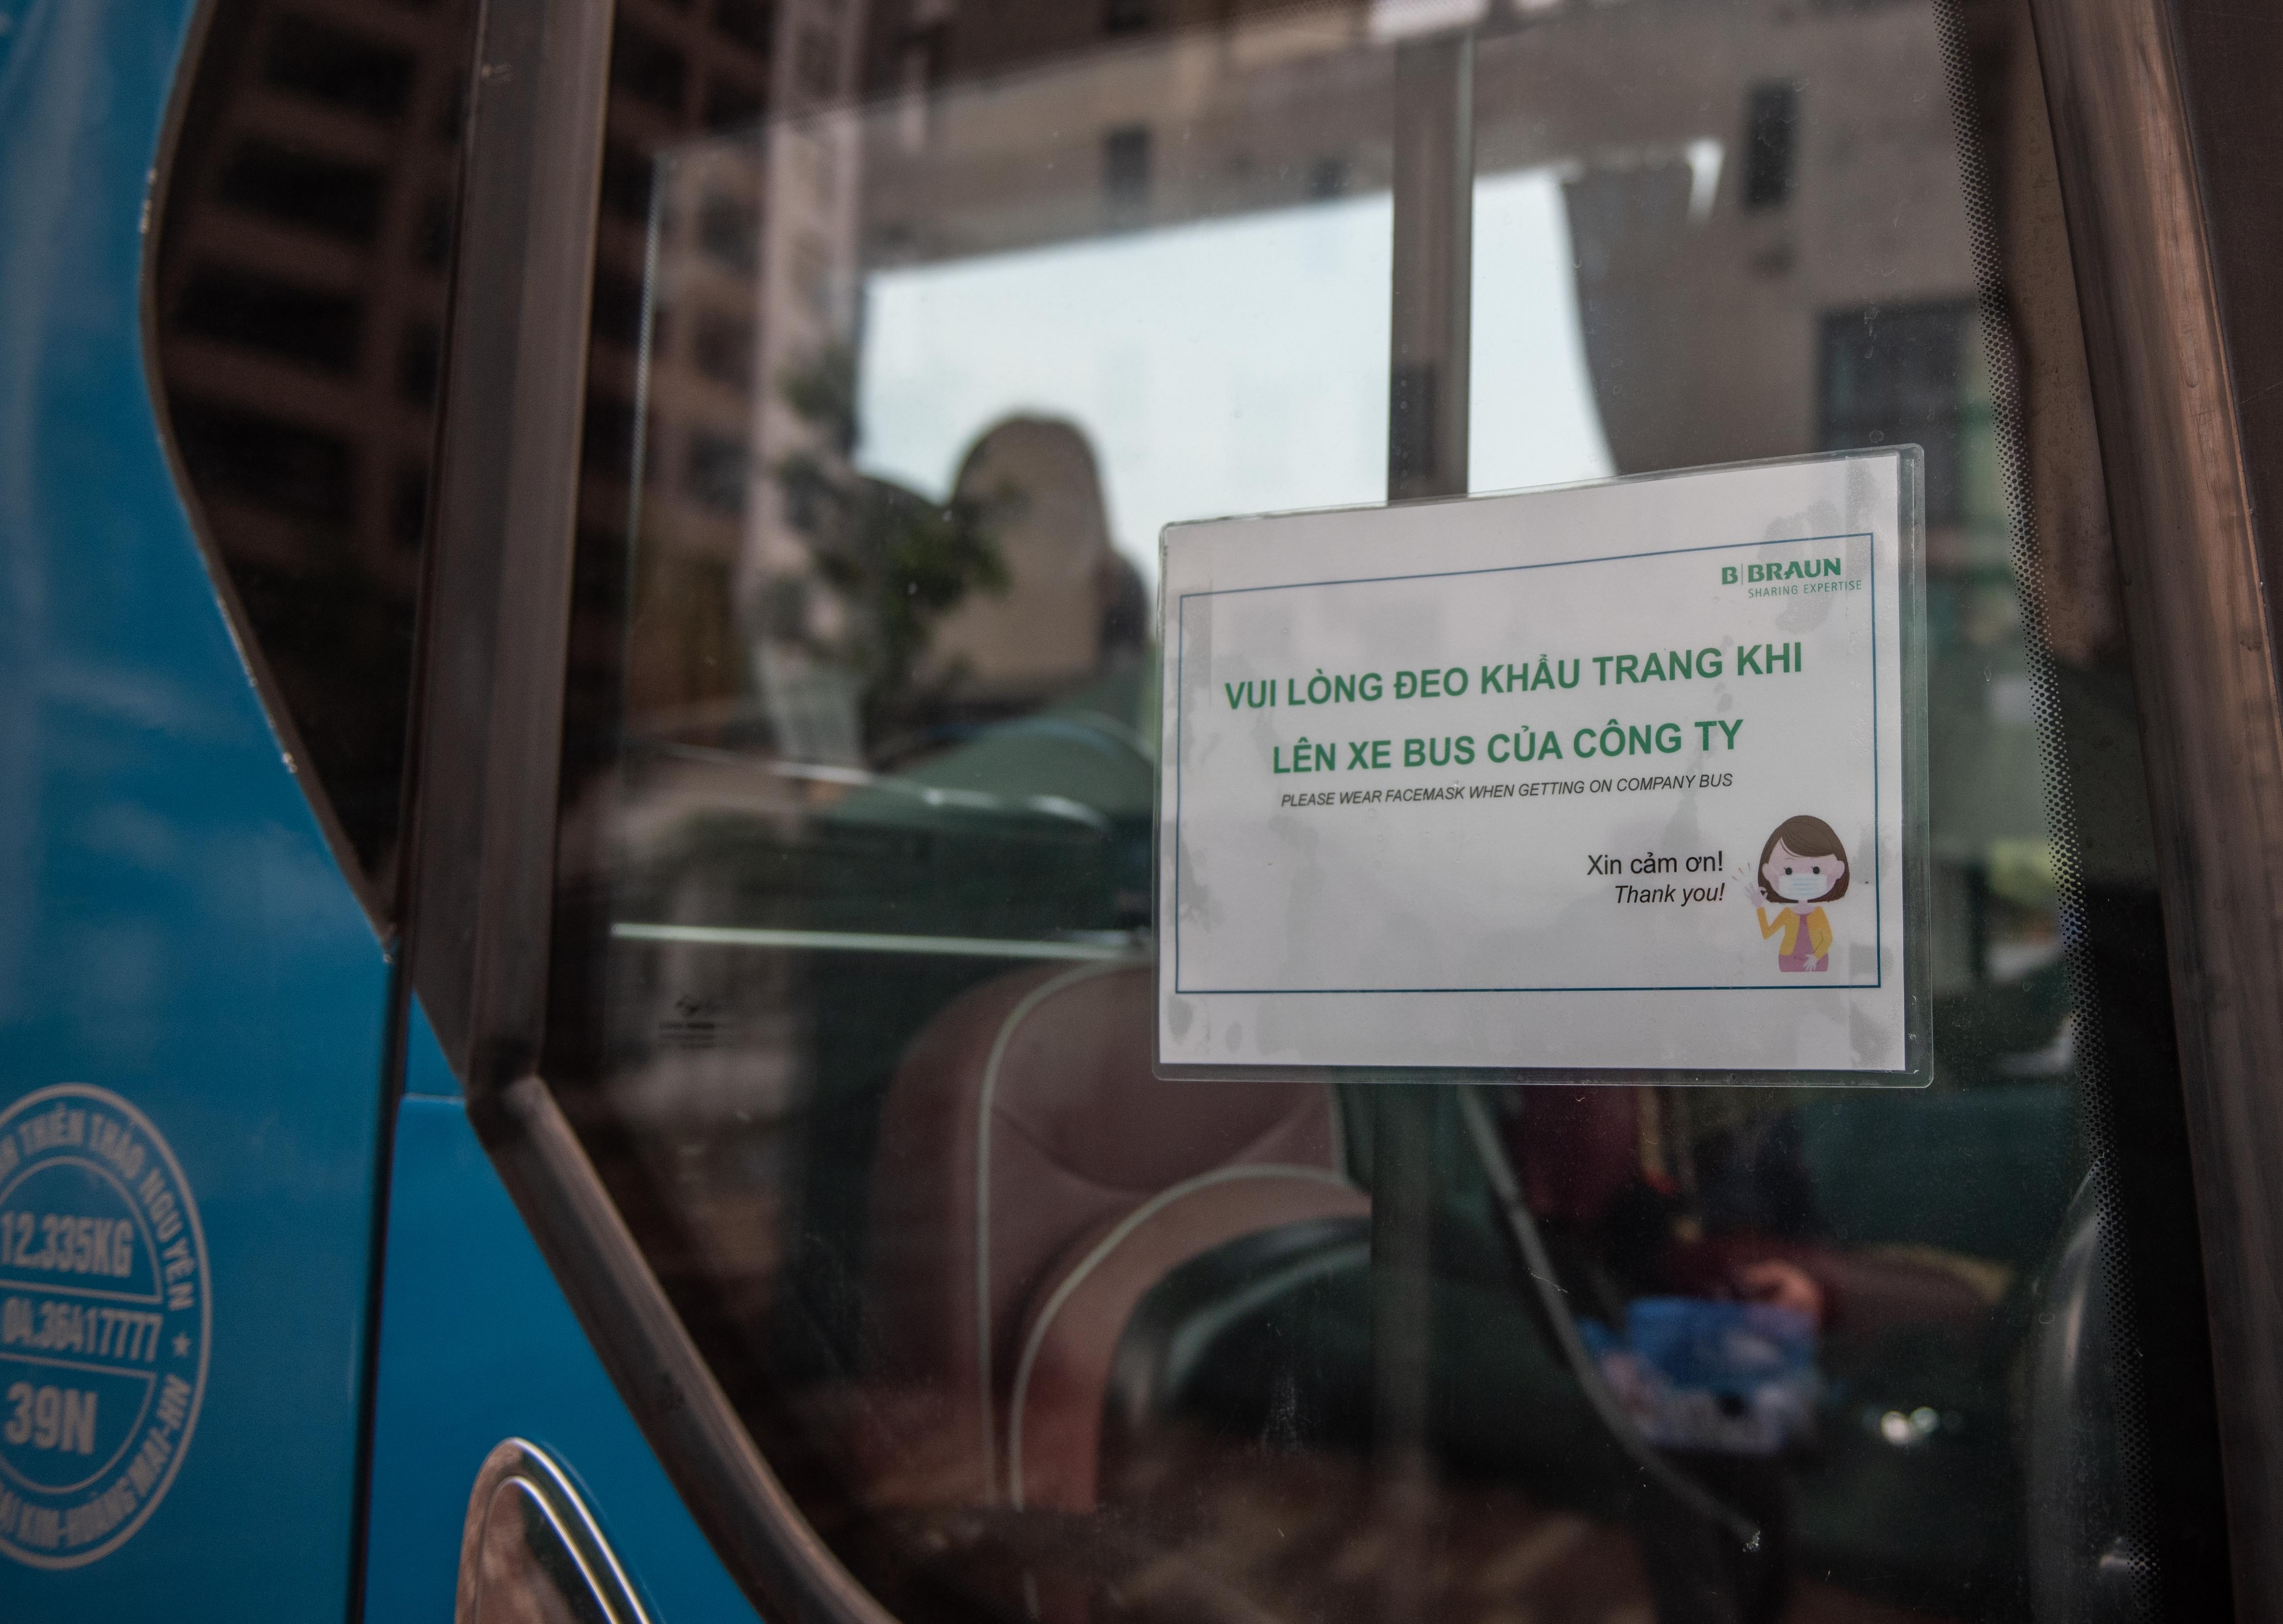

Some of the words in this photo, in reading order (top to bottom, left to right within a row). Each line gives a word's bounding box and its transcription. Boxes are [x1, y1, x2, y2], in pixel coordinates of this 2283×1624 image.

[1748, 558, 1841, 583] BRAUN
[1748, 585, 1798, 598] SHARING
[1804, 580, 1862, 594] EXPERTISE
[1225, 679, 1276, 710] VUI
[1288, 668, 1383, 706] LÒNG
[1394, 667, 1469, 699] ĐEO
[1481, 654, 1580, 694] KHẨU
[1592, 647, 1723, 686] TRANG
[1737, 642, 1802, 676] KHI
[1273, 736, 1336, 773] LÊN
[1347, 740, 1391, 770] XE
[1404, 735, 1475, 767] BUS
[1487, 725, 1563, 763] CỦA
[1573, 719, 1681, 758] CÔNG
[1694, 719, 1744, 751] TY
[1281, 792, 1336, 807] PLEASE
[1340, 790, 1382, 804] WEAR
[1385, 786, 1465, 803] FACEMASK
[1469, 784, 1514, 799] WHEN
[1518, 781, 1585, 796] GETTING
[1589, 779, 1612, 793] ON
[1617, 775, 1696, 792] COMPANY
[1699, 773, 1733, 787] BUS
[1587, 854, 1622, 876] Xin
[1631, 852, 1677, 874] cảm
[1686, 850, 1723, 872] ơn!
[1615, 884, 1677, 904] Thank
[1681, 882, 1725, 907] you!
[4, 1381, 97, 1455] 39N
